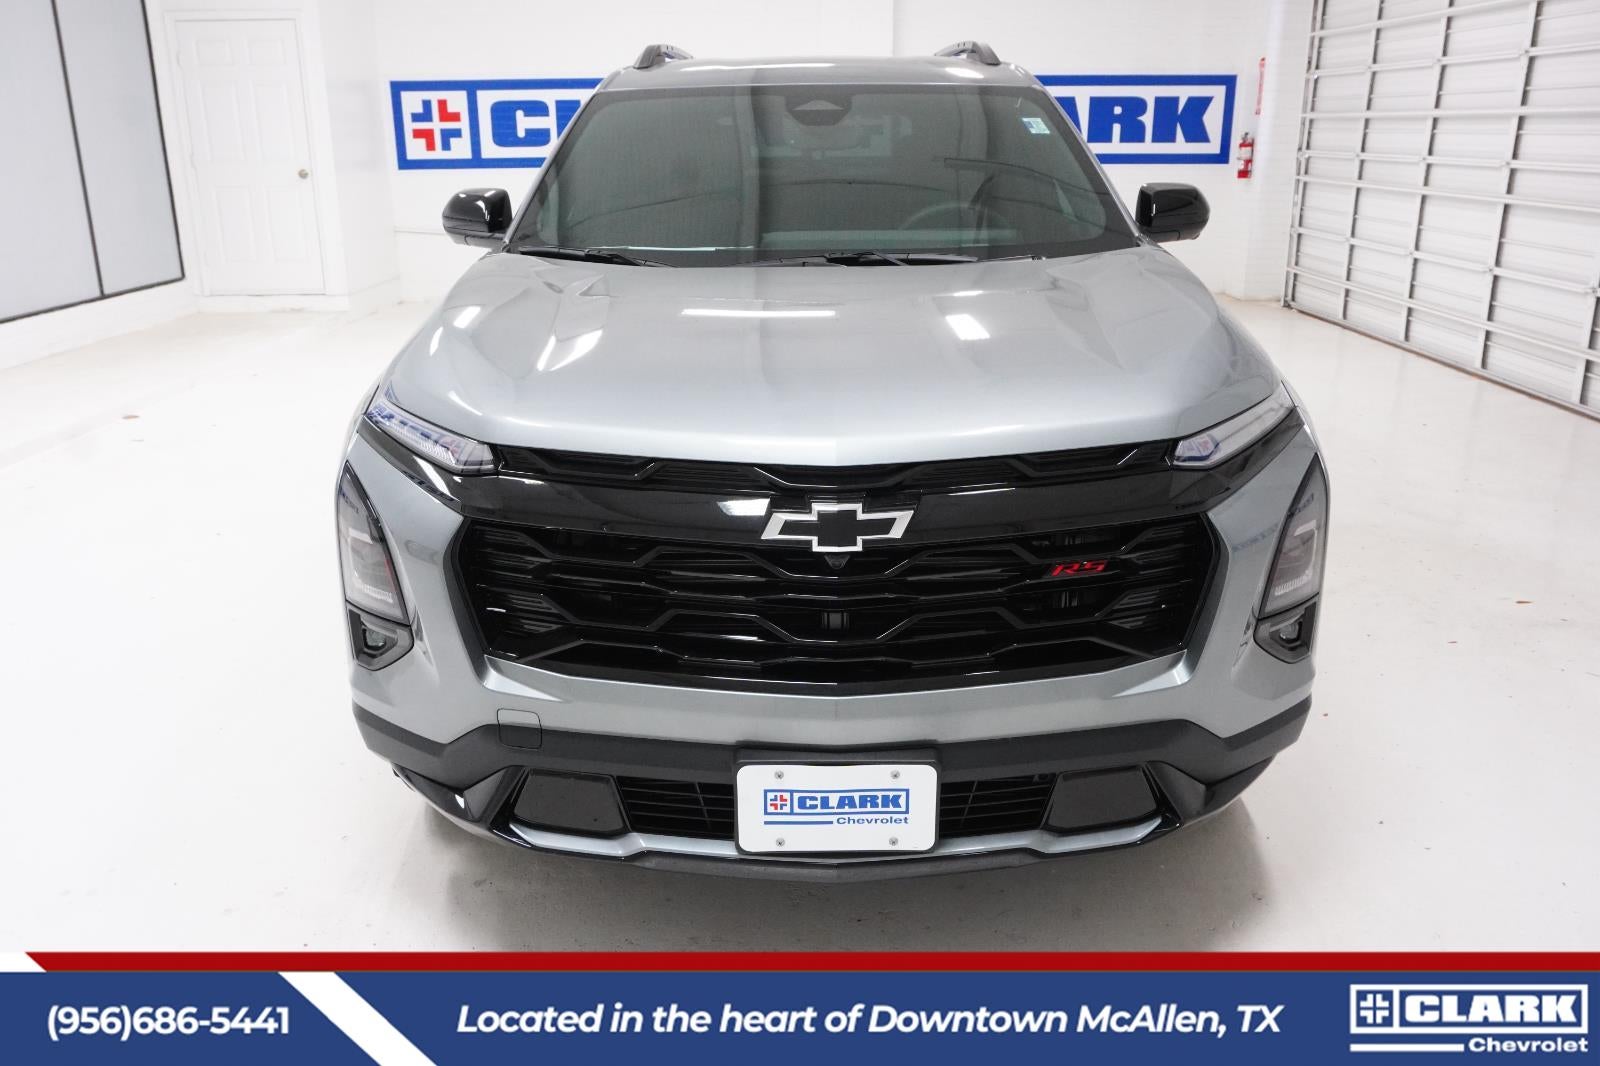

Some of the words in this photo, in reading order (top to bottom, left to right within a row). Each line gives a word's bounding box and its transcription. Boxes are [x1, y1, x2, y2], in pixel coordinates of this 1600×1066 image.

[1051, 561, 1106, 576] RS
[797, 794, 903, 810] CLARK
[836, 816, 909, 825] Chevrolet
